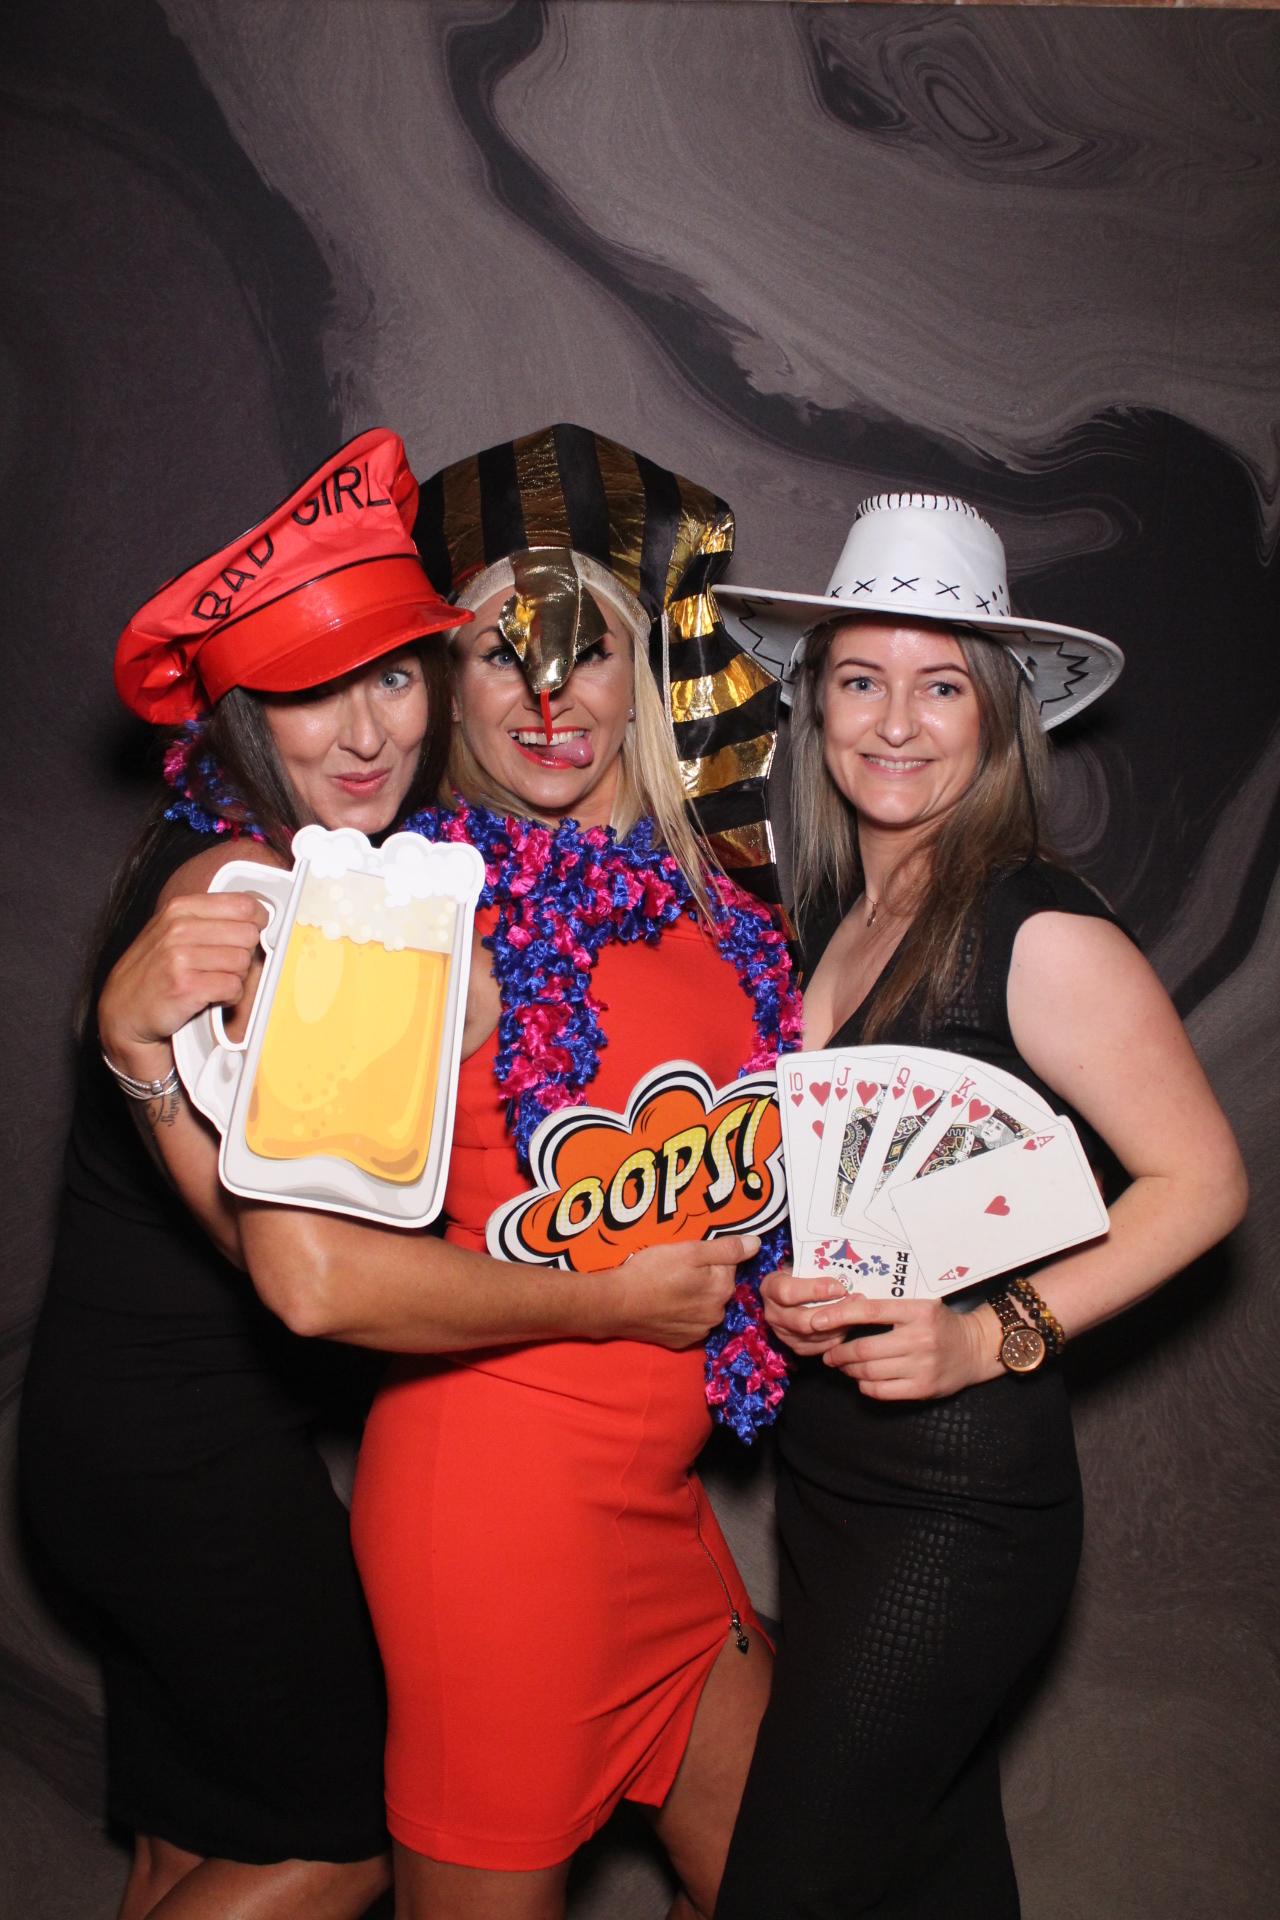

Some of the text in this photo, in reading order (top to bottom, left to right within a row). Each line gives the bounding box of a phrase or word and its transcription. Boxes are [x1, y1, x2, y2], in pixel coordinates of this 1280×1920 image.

[291, 462, 392, 526] GIRL
[789, 1072, 804, 1091] 10
[836, 1067, 852, 1086] J
[896, 1067, 911, 1087] Q
[955, 1076, 977, 1098] K
[1036, 1135, 1055, 1148] A
[547, 1095, 772, 1243] OOPS!
[891, 1251, 910, 1298] OKER
[938, 1268, 957, 1281] A
